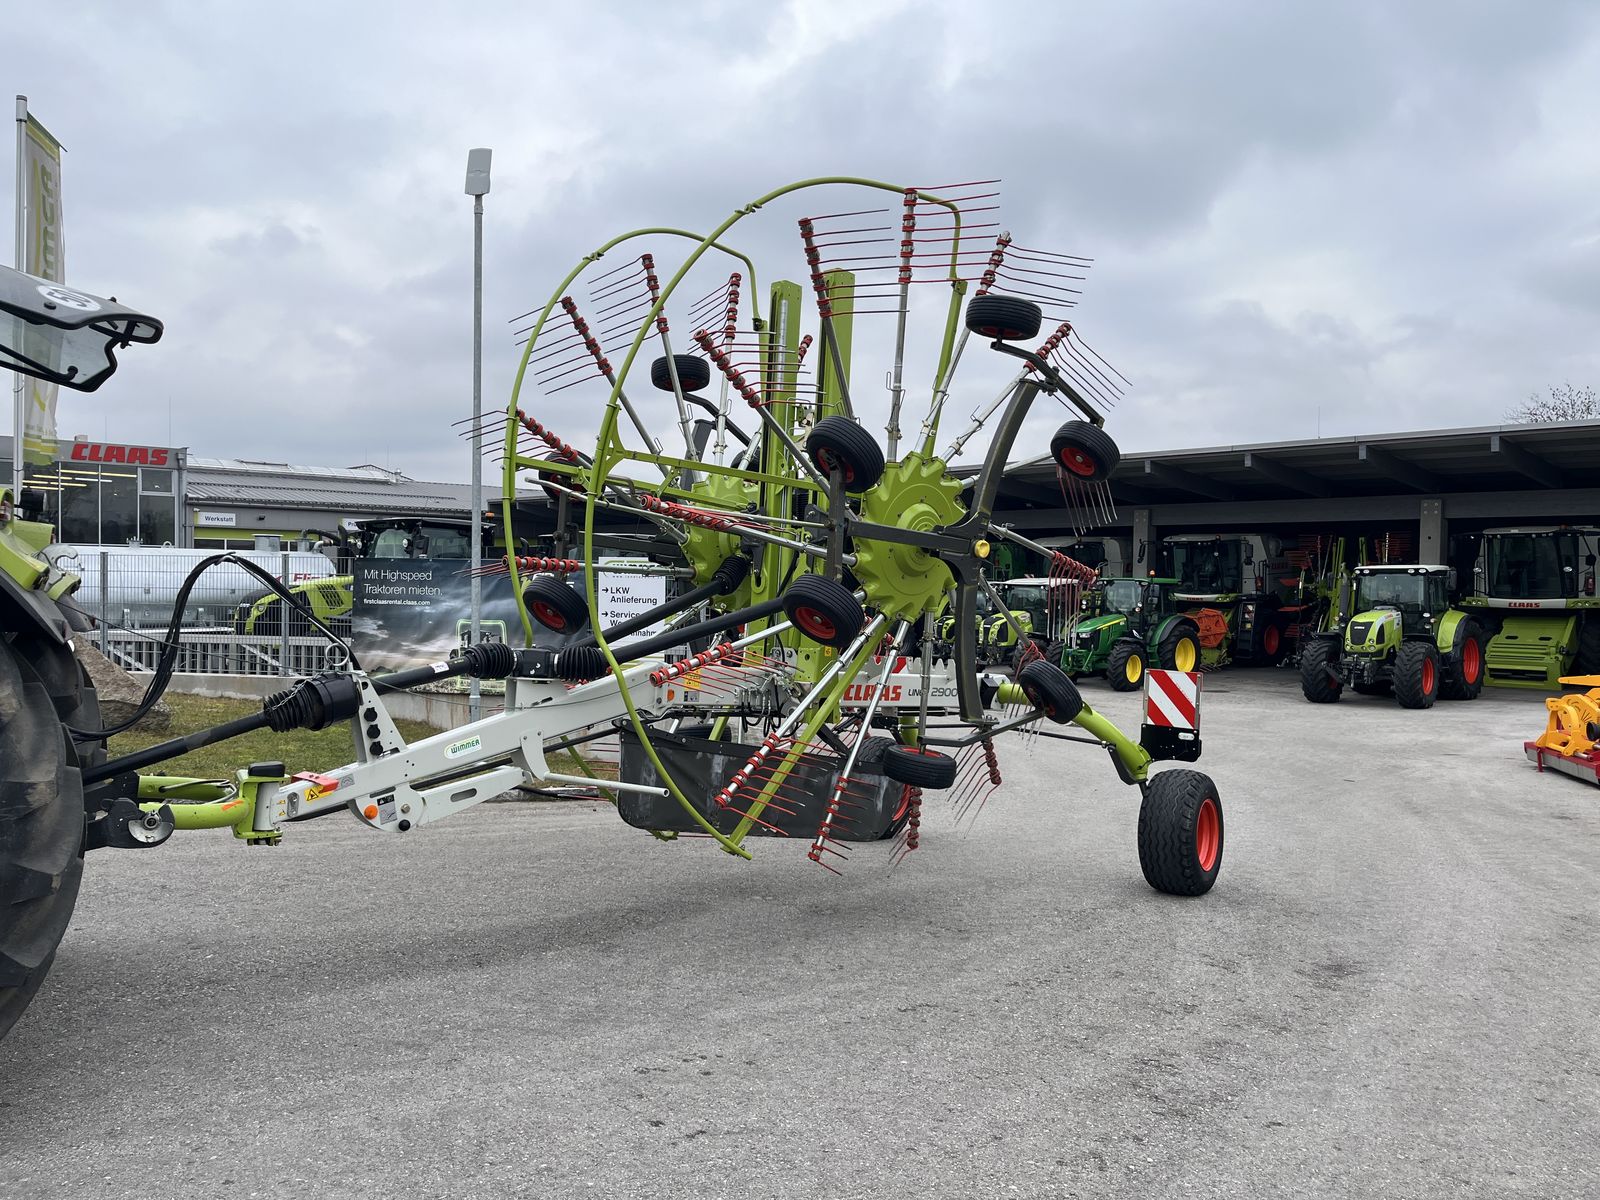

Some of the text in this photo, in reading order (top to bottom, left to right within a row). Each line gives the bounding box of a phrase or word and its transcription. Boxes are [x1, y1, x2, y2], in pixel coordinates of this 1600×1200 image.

[70, 443, 169, 466] CLAAS
[204, 515, 234, 523] Werkstatt
[364, 569, 433, 582] Mit Highspeed
[364, 583, 443, 597] Traktoren mieten.
[363, 598, 431, 606] firstclaasrental.claas.com
[610, 596, 658, 605] Anlieferung
[931, 688, 958, 697] 2900
